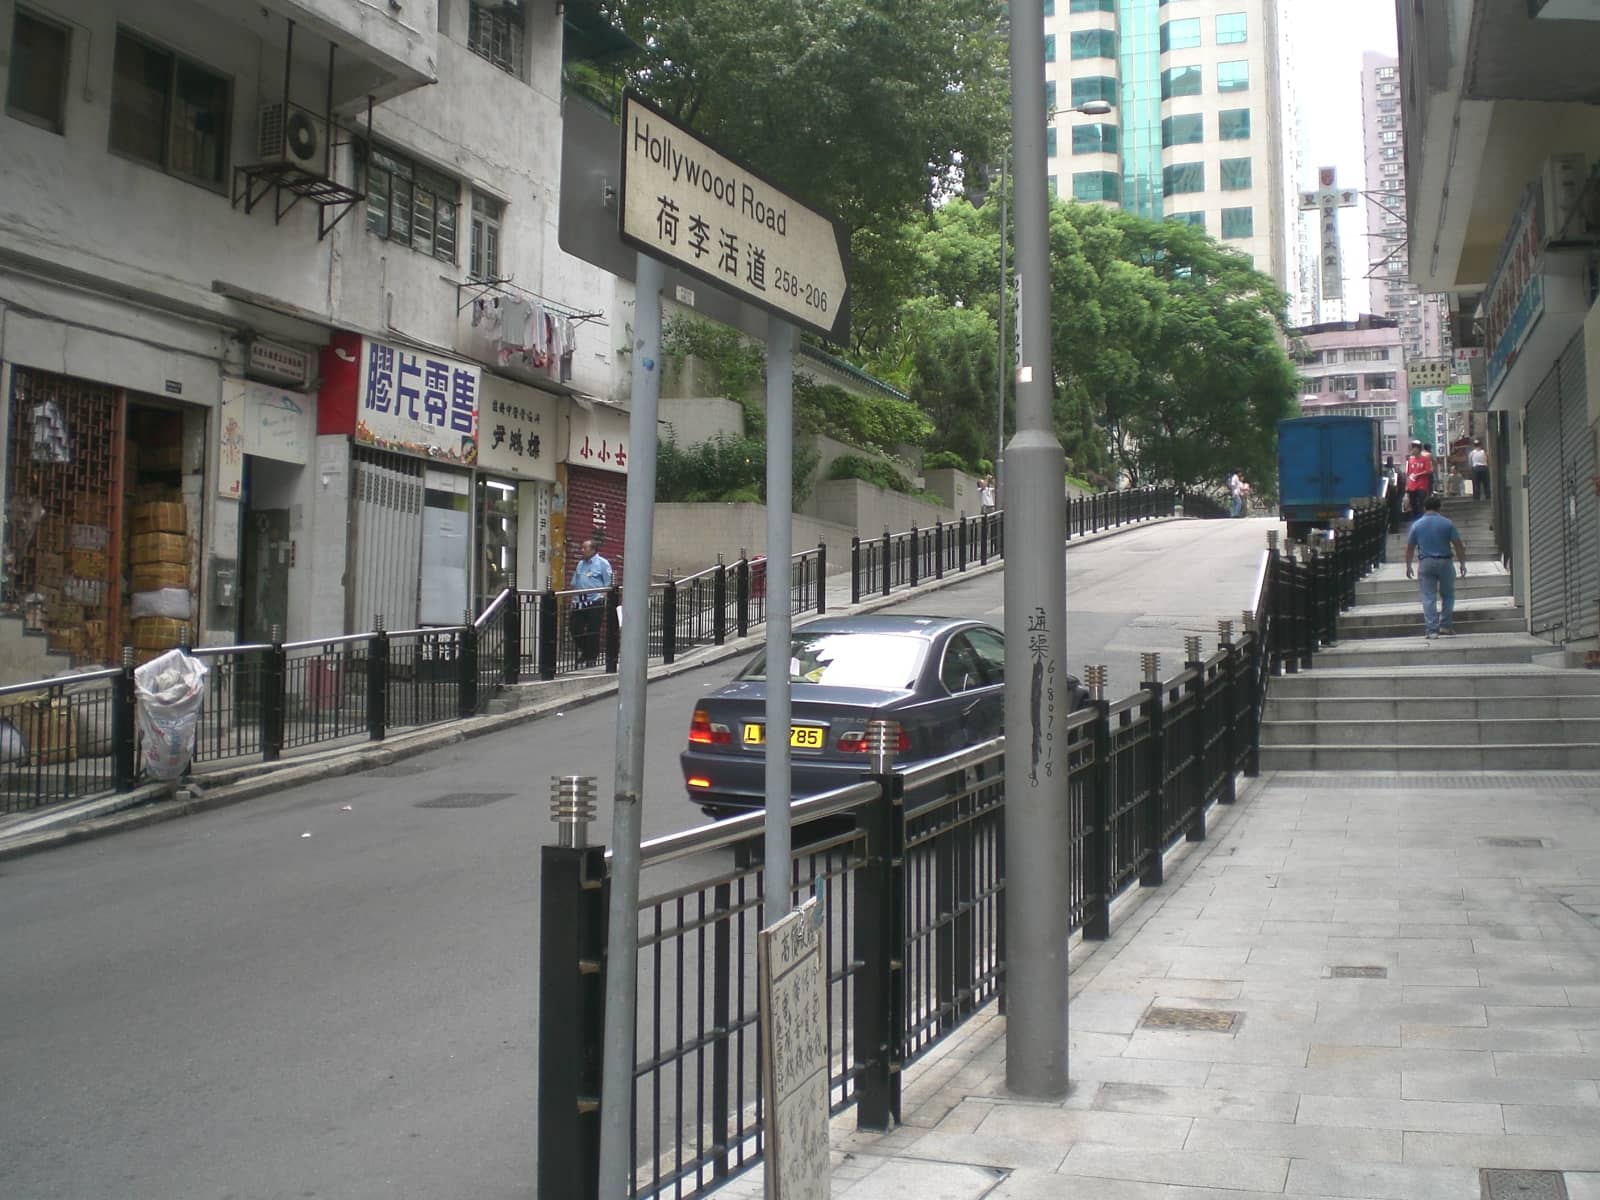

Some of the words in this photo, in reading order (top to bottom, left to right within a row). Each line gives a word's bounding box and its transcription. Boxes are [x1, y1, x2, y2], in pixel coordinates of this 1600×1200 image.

[634, 117, 736, 208] Hollywood
[742, 182, 787, 237] Road
[656, 194, 767, 292] 荷李活道
[774, 267, 828, 313] 258-206
[364, 342, 475, 434] 膠片零售
